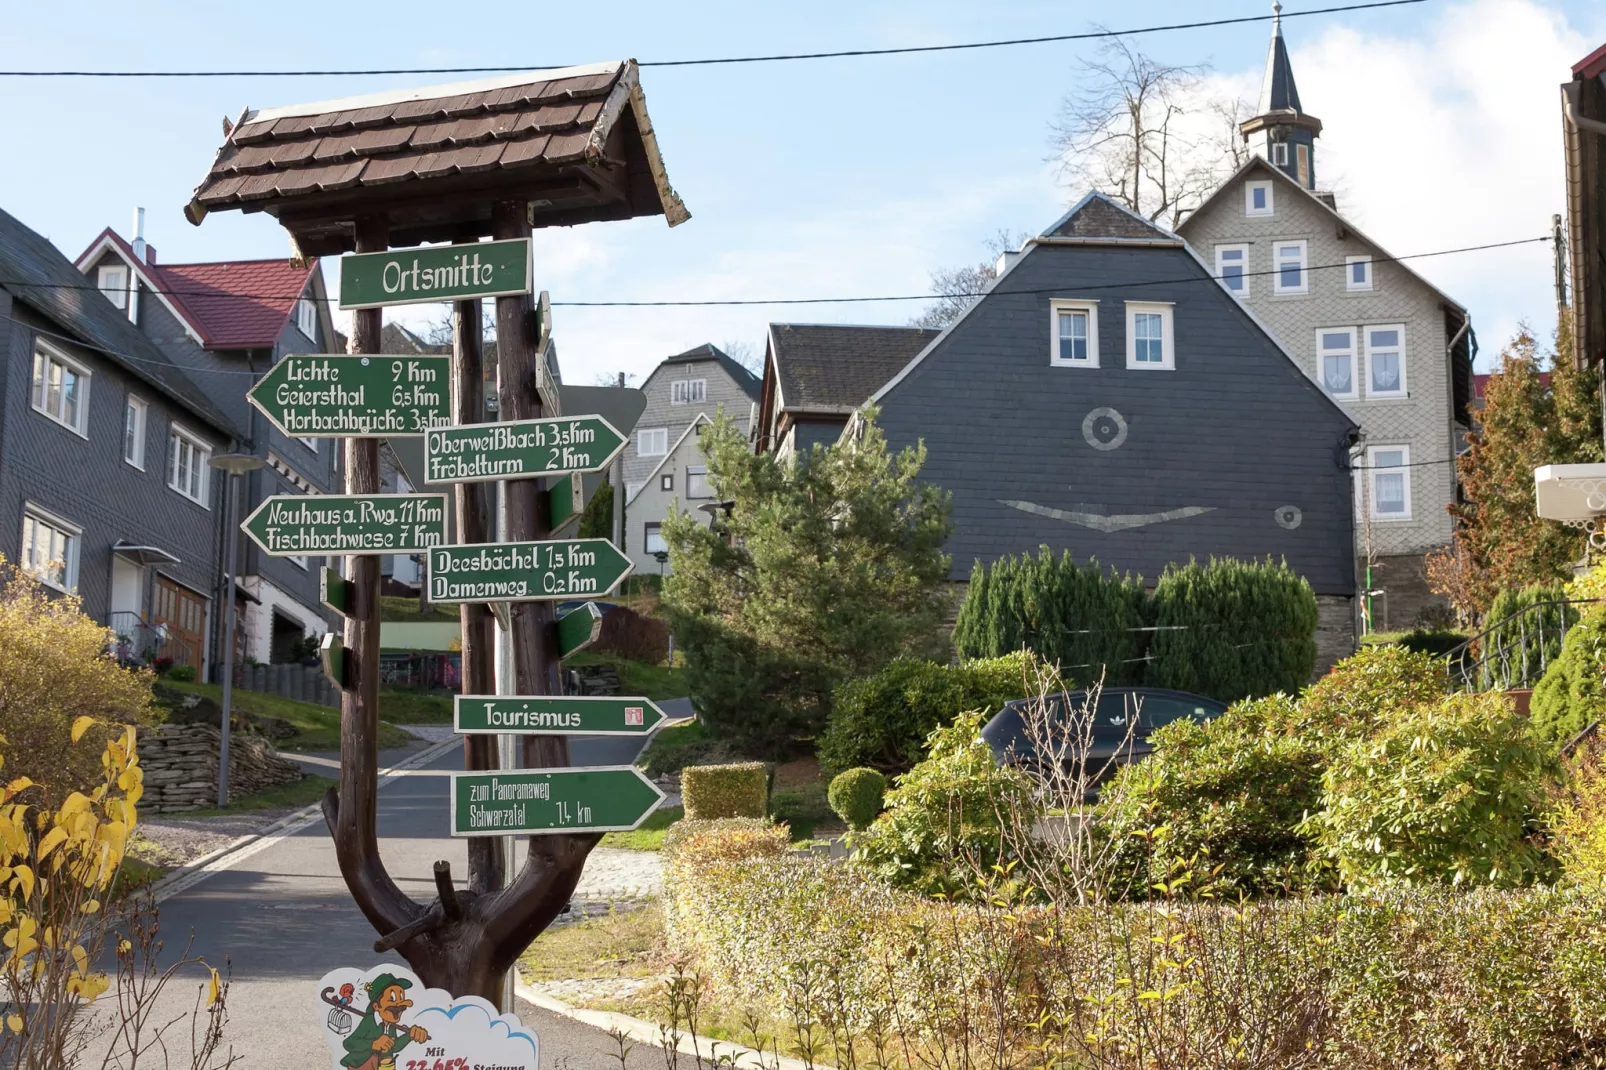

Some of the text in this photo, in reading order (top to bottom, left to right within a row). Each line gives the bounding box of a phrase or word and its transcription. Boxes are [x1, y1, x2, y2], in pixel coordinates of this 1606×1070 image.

[383, 253, 493, 293] Ortsmitte
[287, 359, 339, 381] Lichte
[391, 361, 403, 383] 9
[276, 383, 365, 406] Geiersthal
[283, 408, 404, 431] Horbachbrücke
[430, 425, 545, 454] Oberweißbach
[430, 453, 523, 479] Fröbelturm
[545, 448, 558, 470] 2
[267, 502, 340, 525] Neuhaus
[343, 508, 357, 524] a.
[357, 500, 398, 526] Rwg.
[399, 500, 414, 523] 11
[265, 525, 394, 550] Fischbachwiese
[399, 525, 410, 546] 7
[433, 546, 539, 574] Deesbächel
[543, 571, 566, 594] 0,2
[483, 703, 581, 727] Tourismus
[470, 778, 549, 801] zum Panoramaweg
[470, 803, 525, 828] Schwarzatal
[577, 801, 592, 824] km
[425, 1047, 446, 1057] Mit
